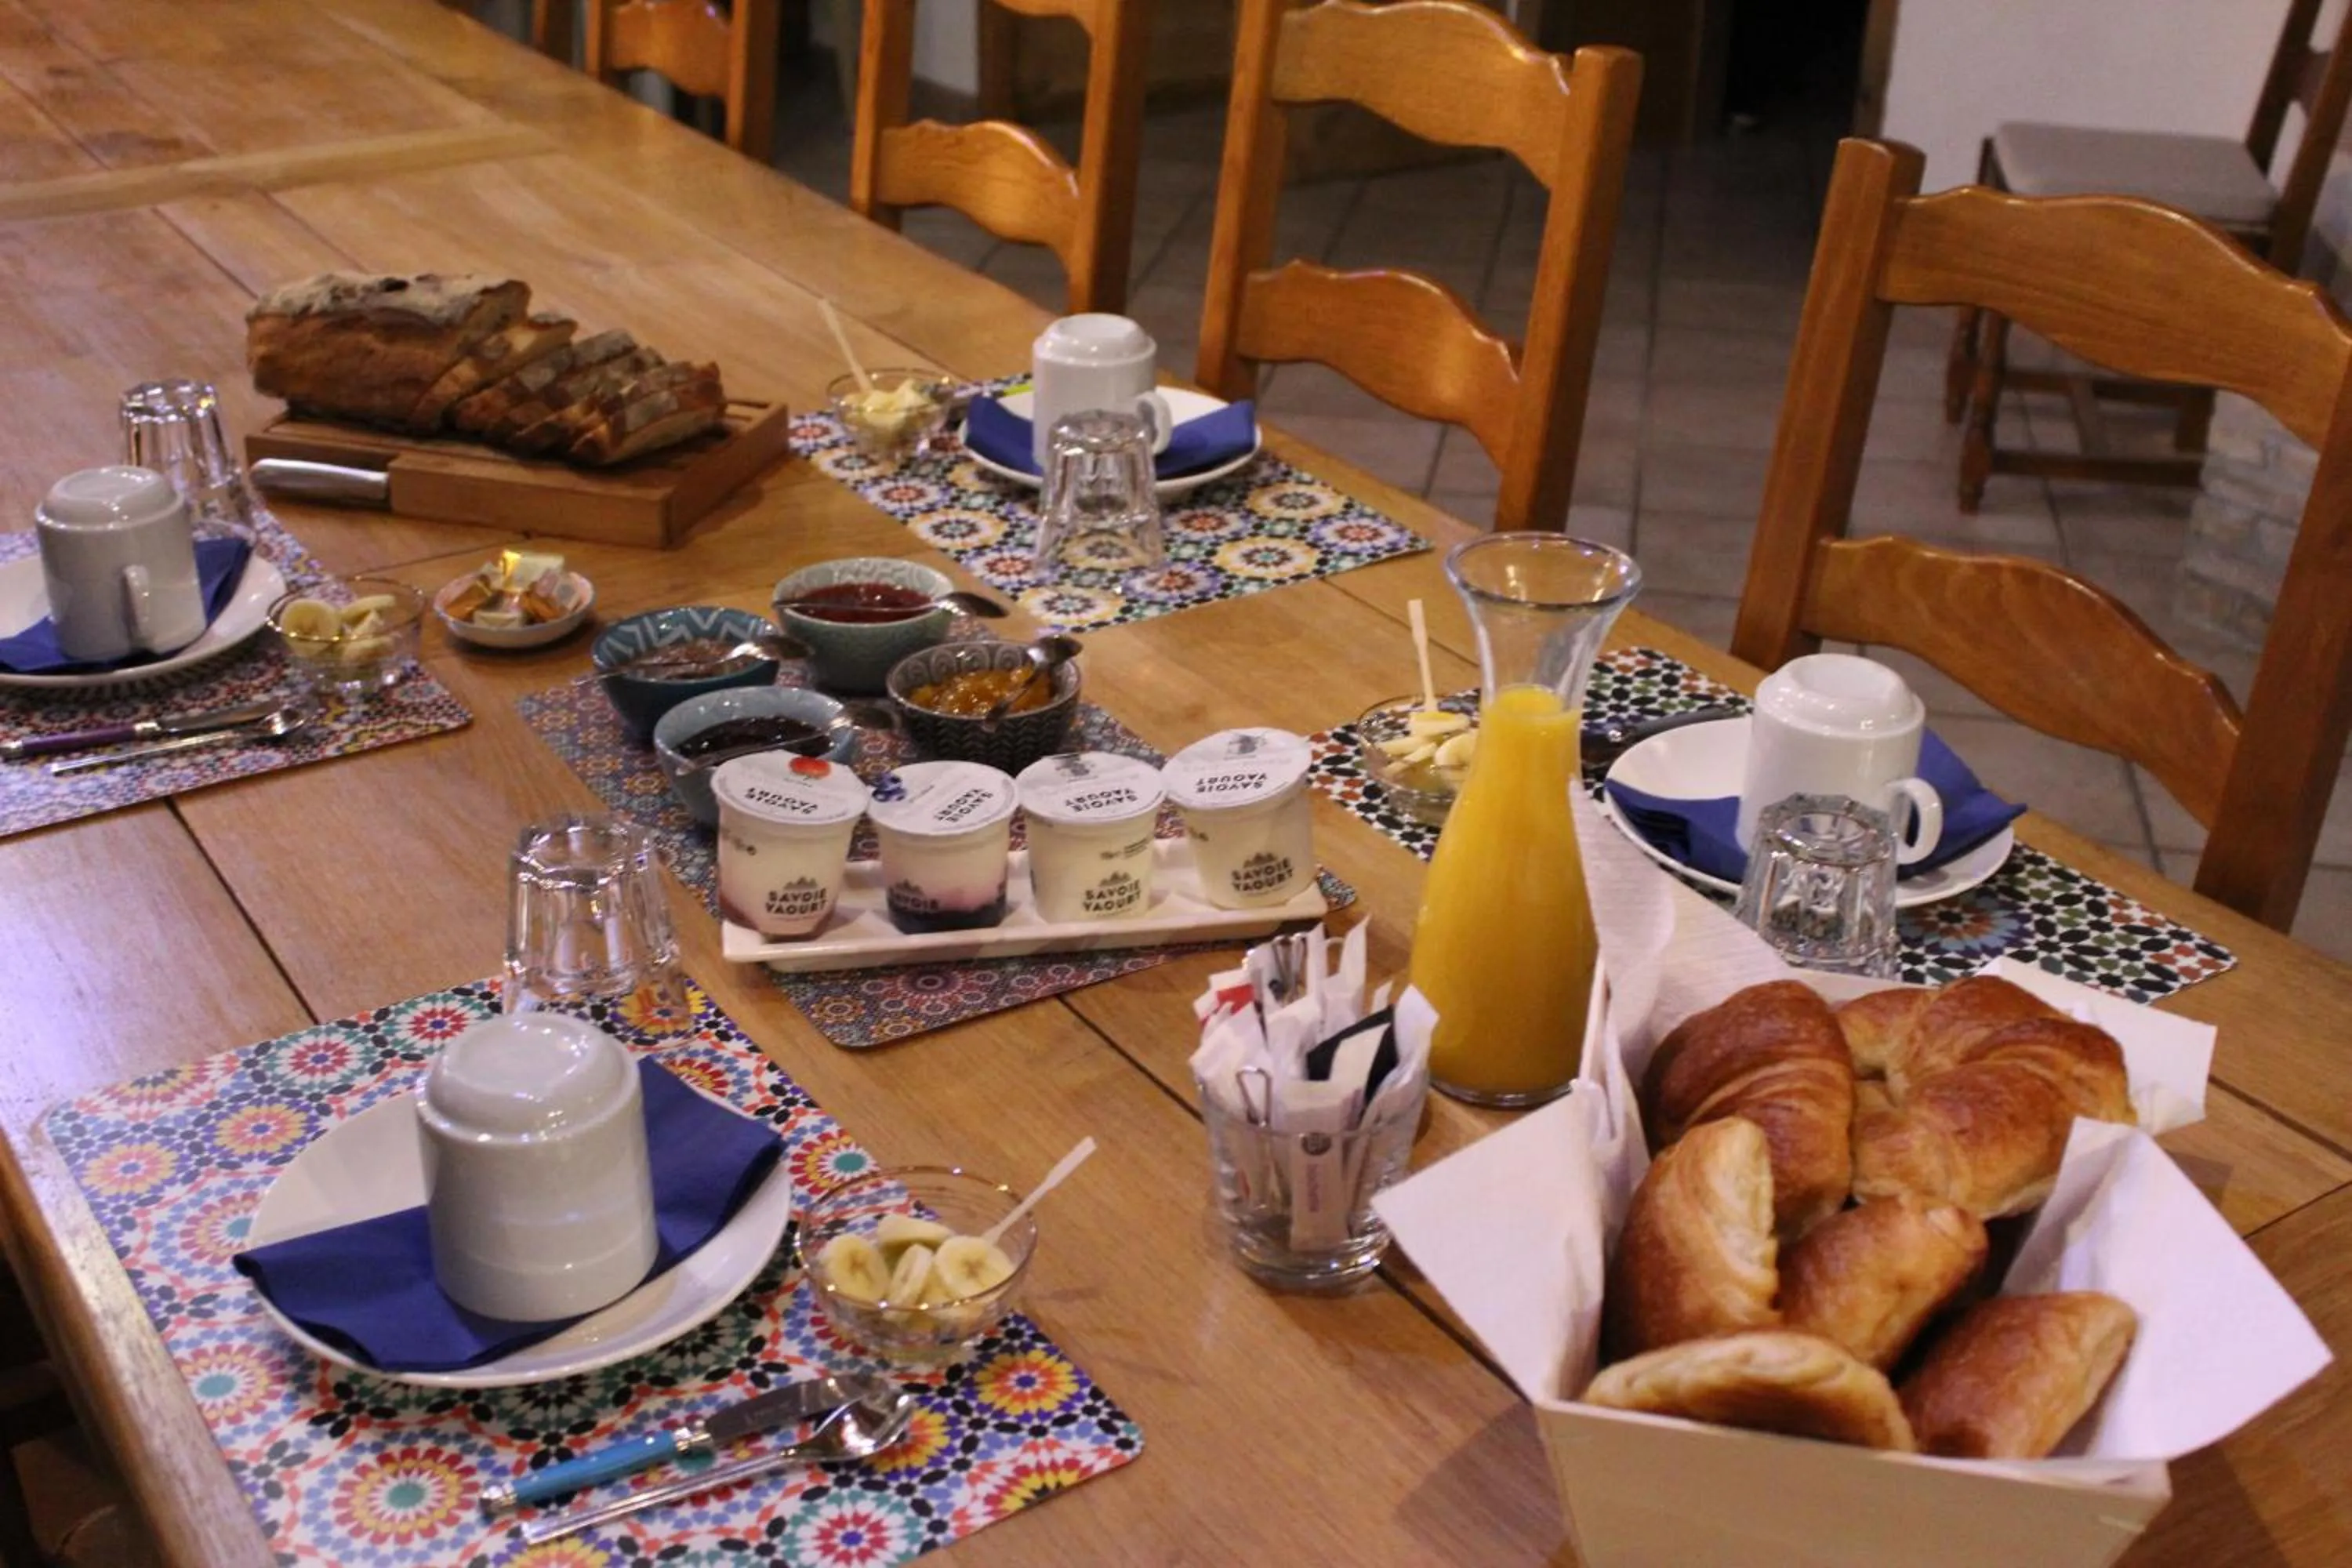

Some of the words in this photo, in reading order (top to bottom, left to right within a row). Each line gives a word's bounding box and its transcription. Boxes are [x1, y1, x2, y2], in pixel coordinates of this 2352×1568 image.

[1195, 772, 1267, 786] YAOURT
[1196, 781, 1263, 793] SAVOIE
[1065, 789, 1134, 806] YAOURT
[1072, 795, 1138, 812] SAVOIE
[1231, 856, 1290, 881] SAVOIE
[1231, 868, 1294, 891] YAOURT
[768, 887, 827, 902] SAVOIE
[1085, 878, 1140, 901] SAVOIE
[765, 899, 827, 916] YAOURT
[1083, 889, 1142, 912] YAOURT
